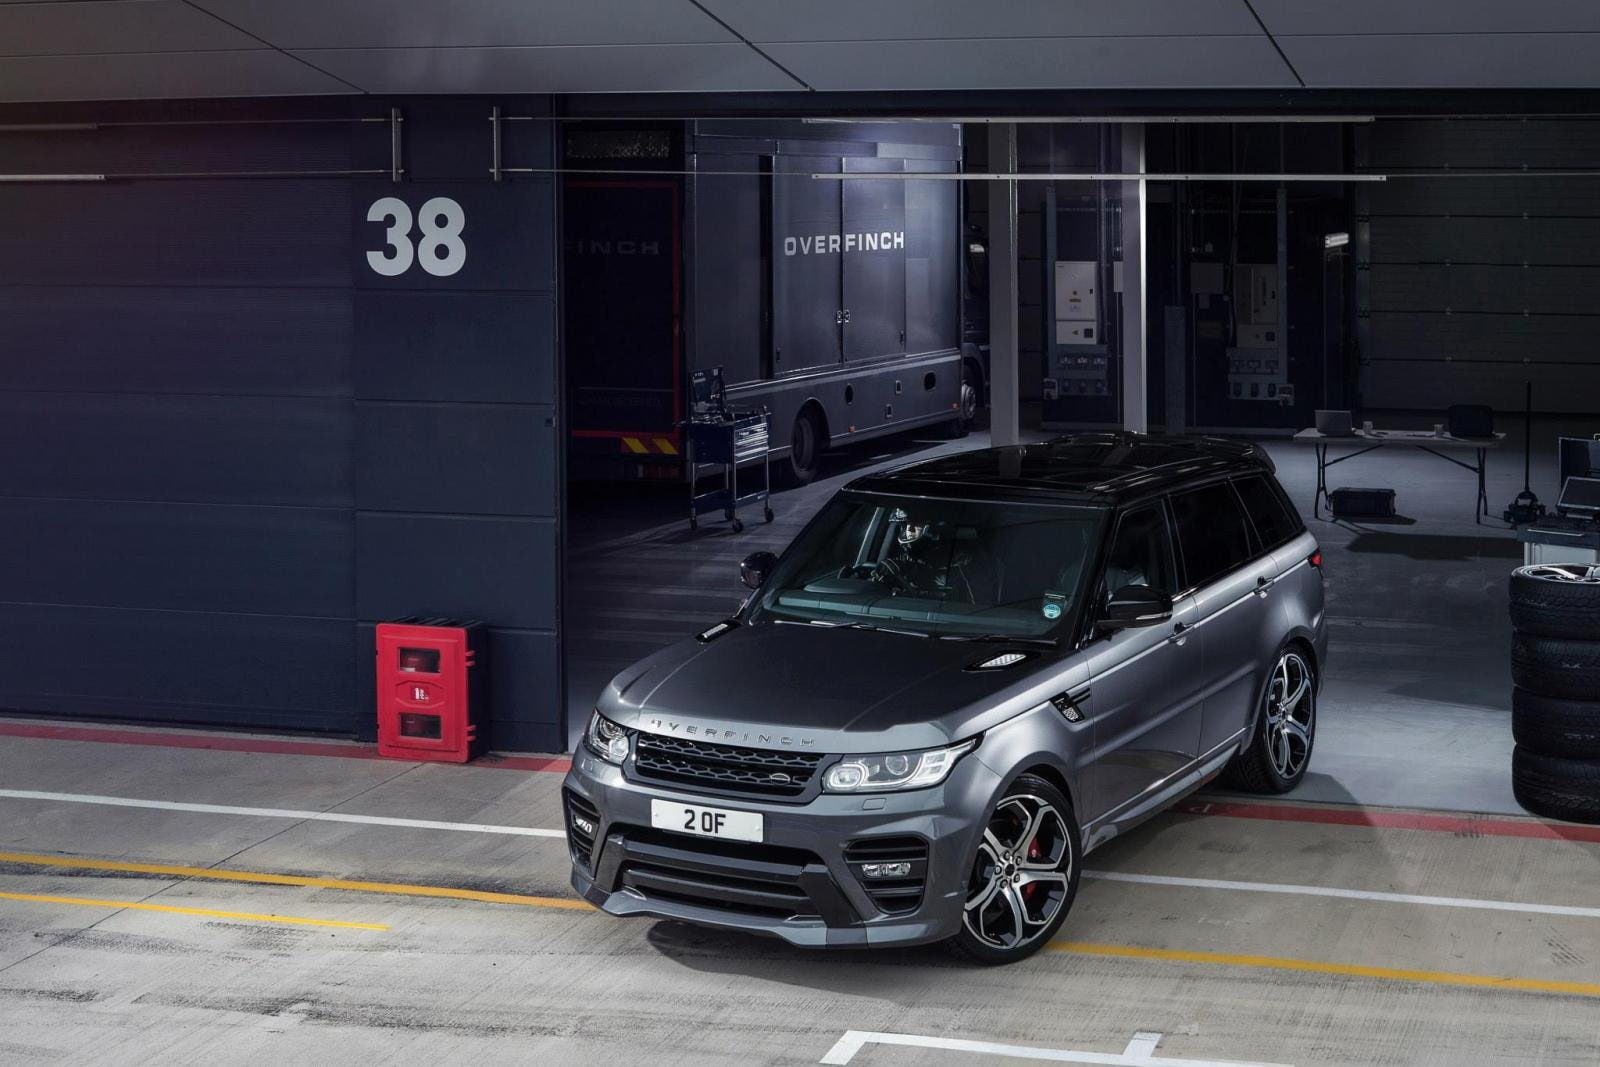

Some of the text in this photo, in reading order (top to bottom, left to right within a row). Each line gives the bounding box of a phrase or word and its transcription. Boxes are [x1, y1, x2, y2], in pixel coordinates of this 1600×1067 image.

[366, 197, 466, 276] 38
[784, 231, 904, 256] OVERFINCH
[684, 809, 726, 834] 2 OF
